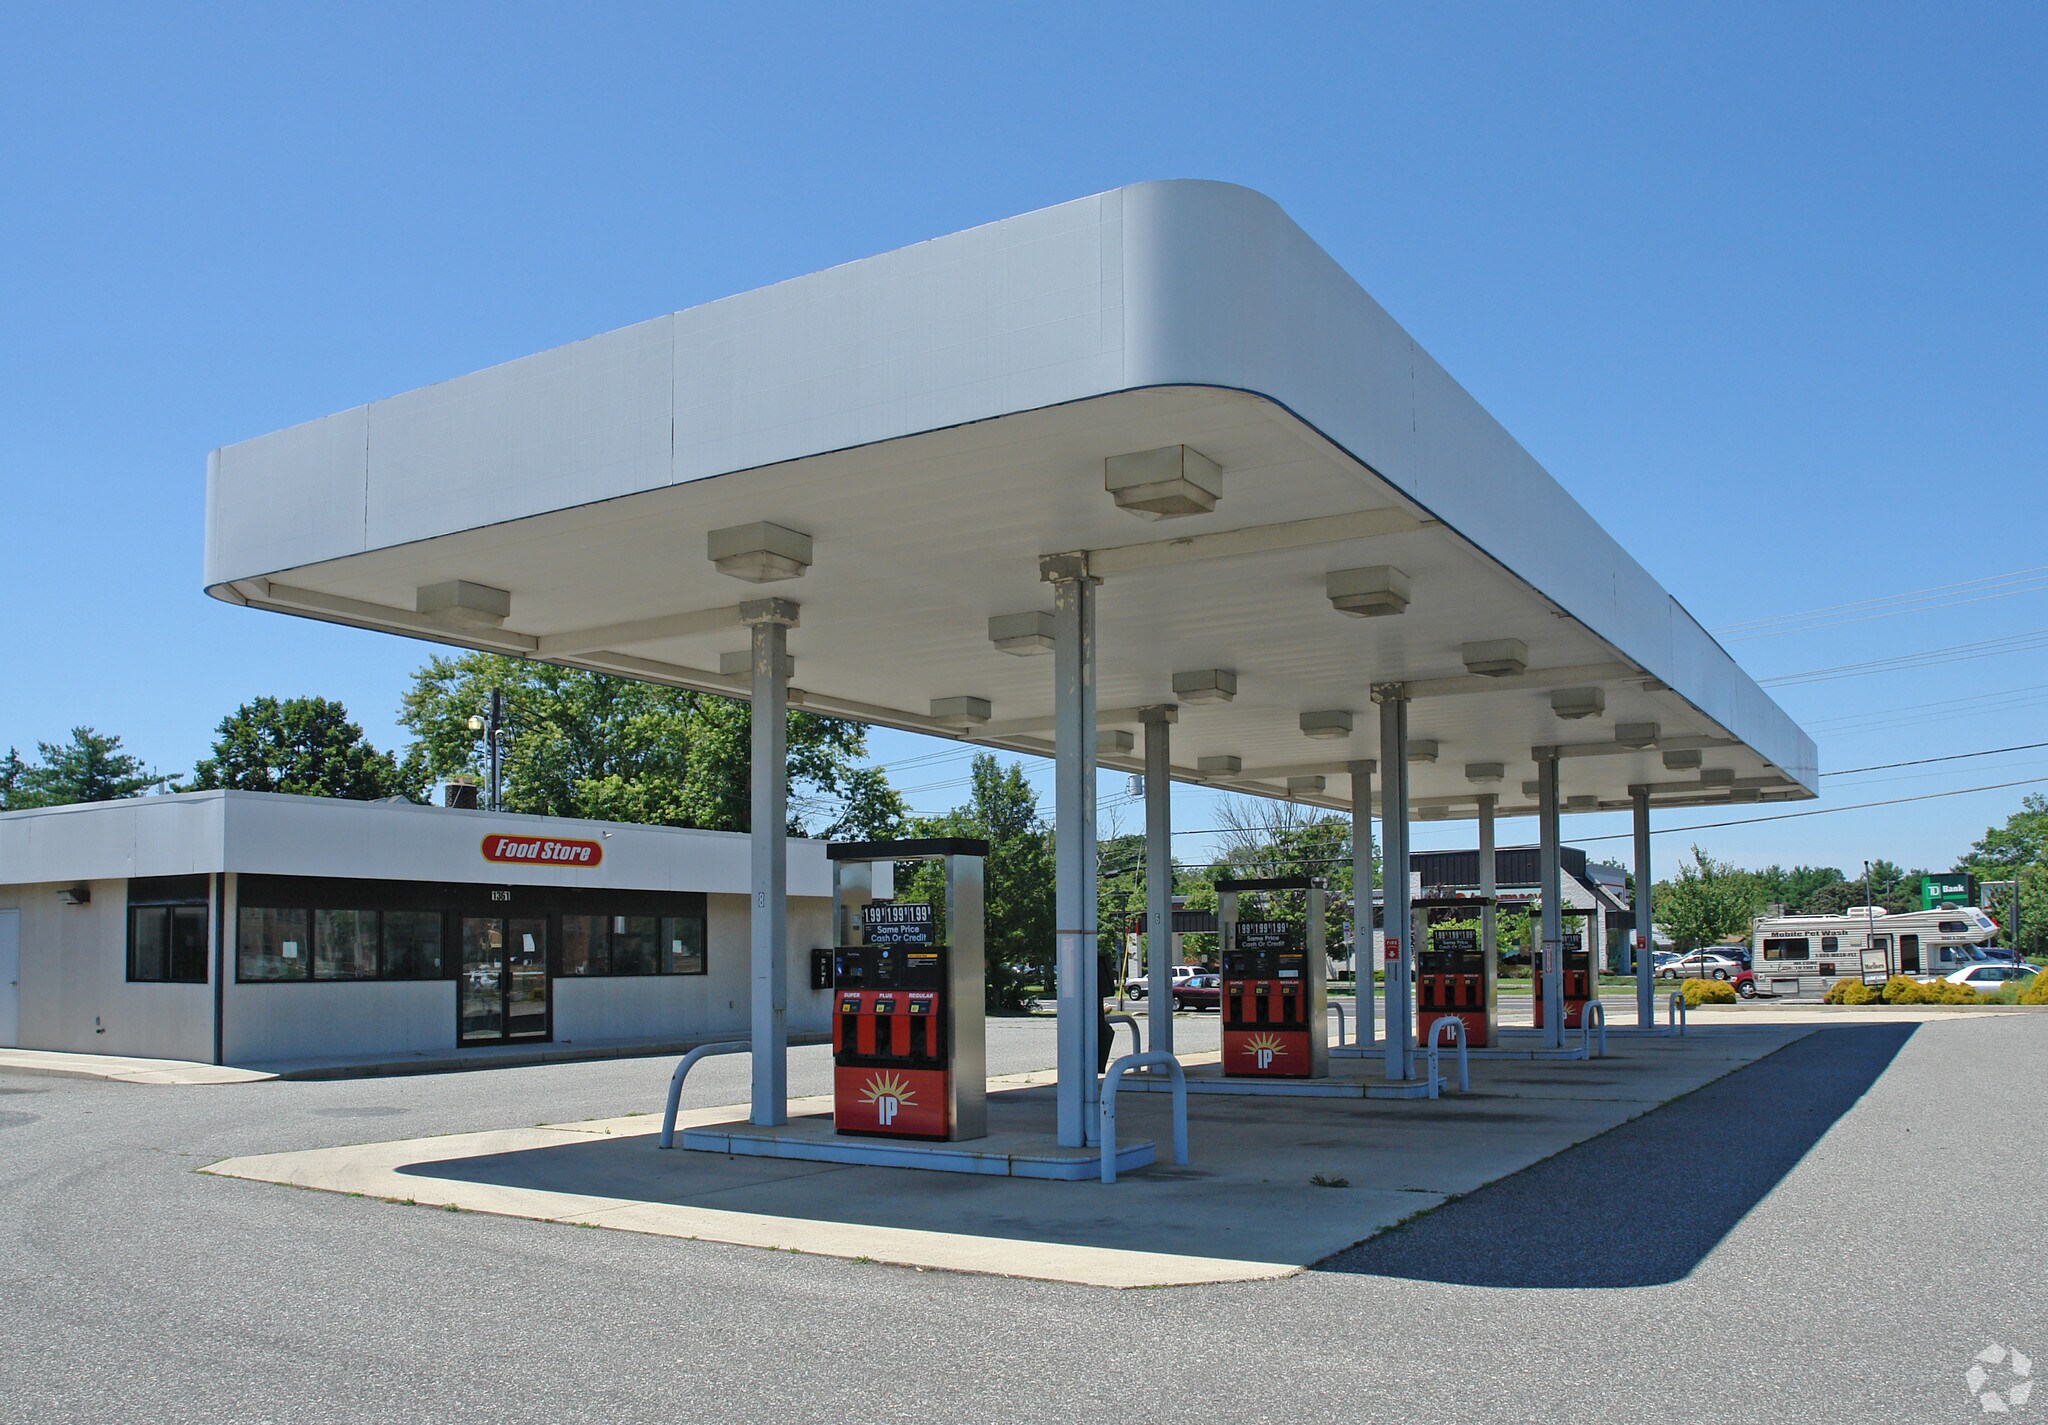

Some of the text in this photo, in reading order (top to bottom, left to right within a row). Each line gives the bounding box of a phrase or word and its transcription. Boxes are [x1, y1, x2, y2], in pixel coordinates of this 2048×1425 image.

[495, 839, 591, 862] Food Store
[1927, 884, 1964, 896] TD Bank
[759, 892, 764, 907] 8
[877, 925, 899, 934] Same
[900, 925, 920, 933] Price
[870, 933, 927, 942] Cash Or Credit
[1257, 1049, 1273, 1069] IP
[878, 1096, 898, 1126] IP
